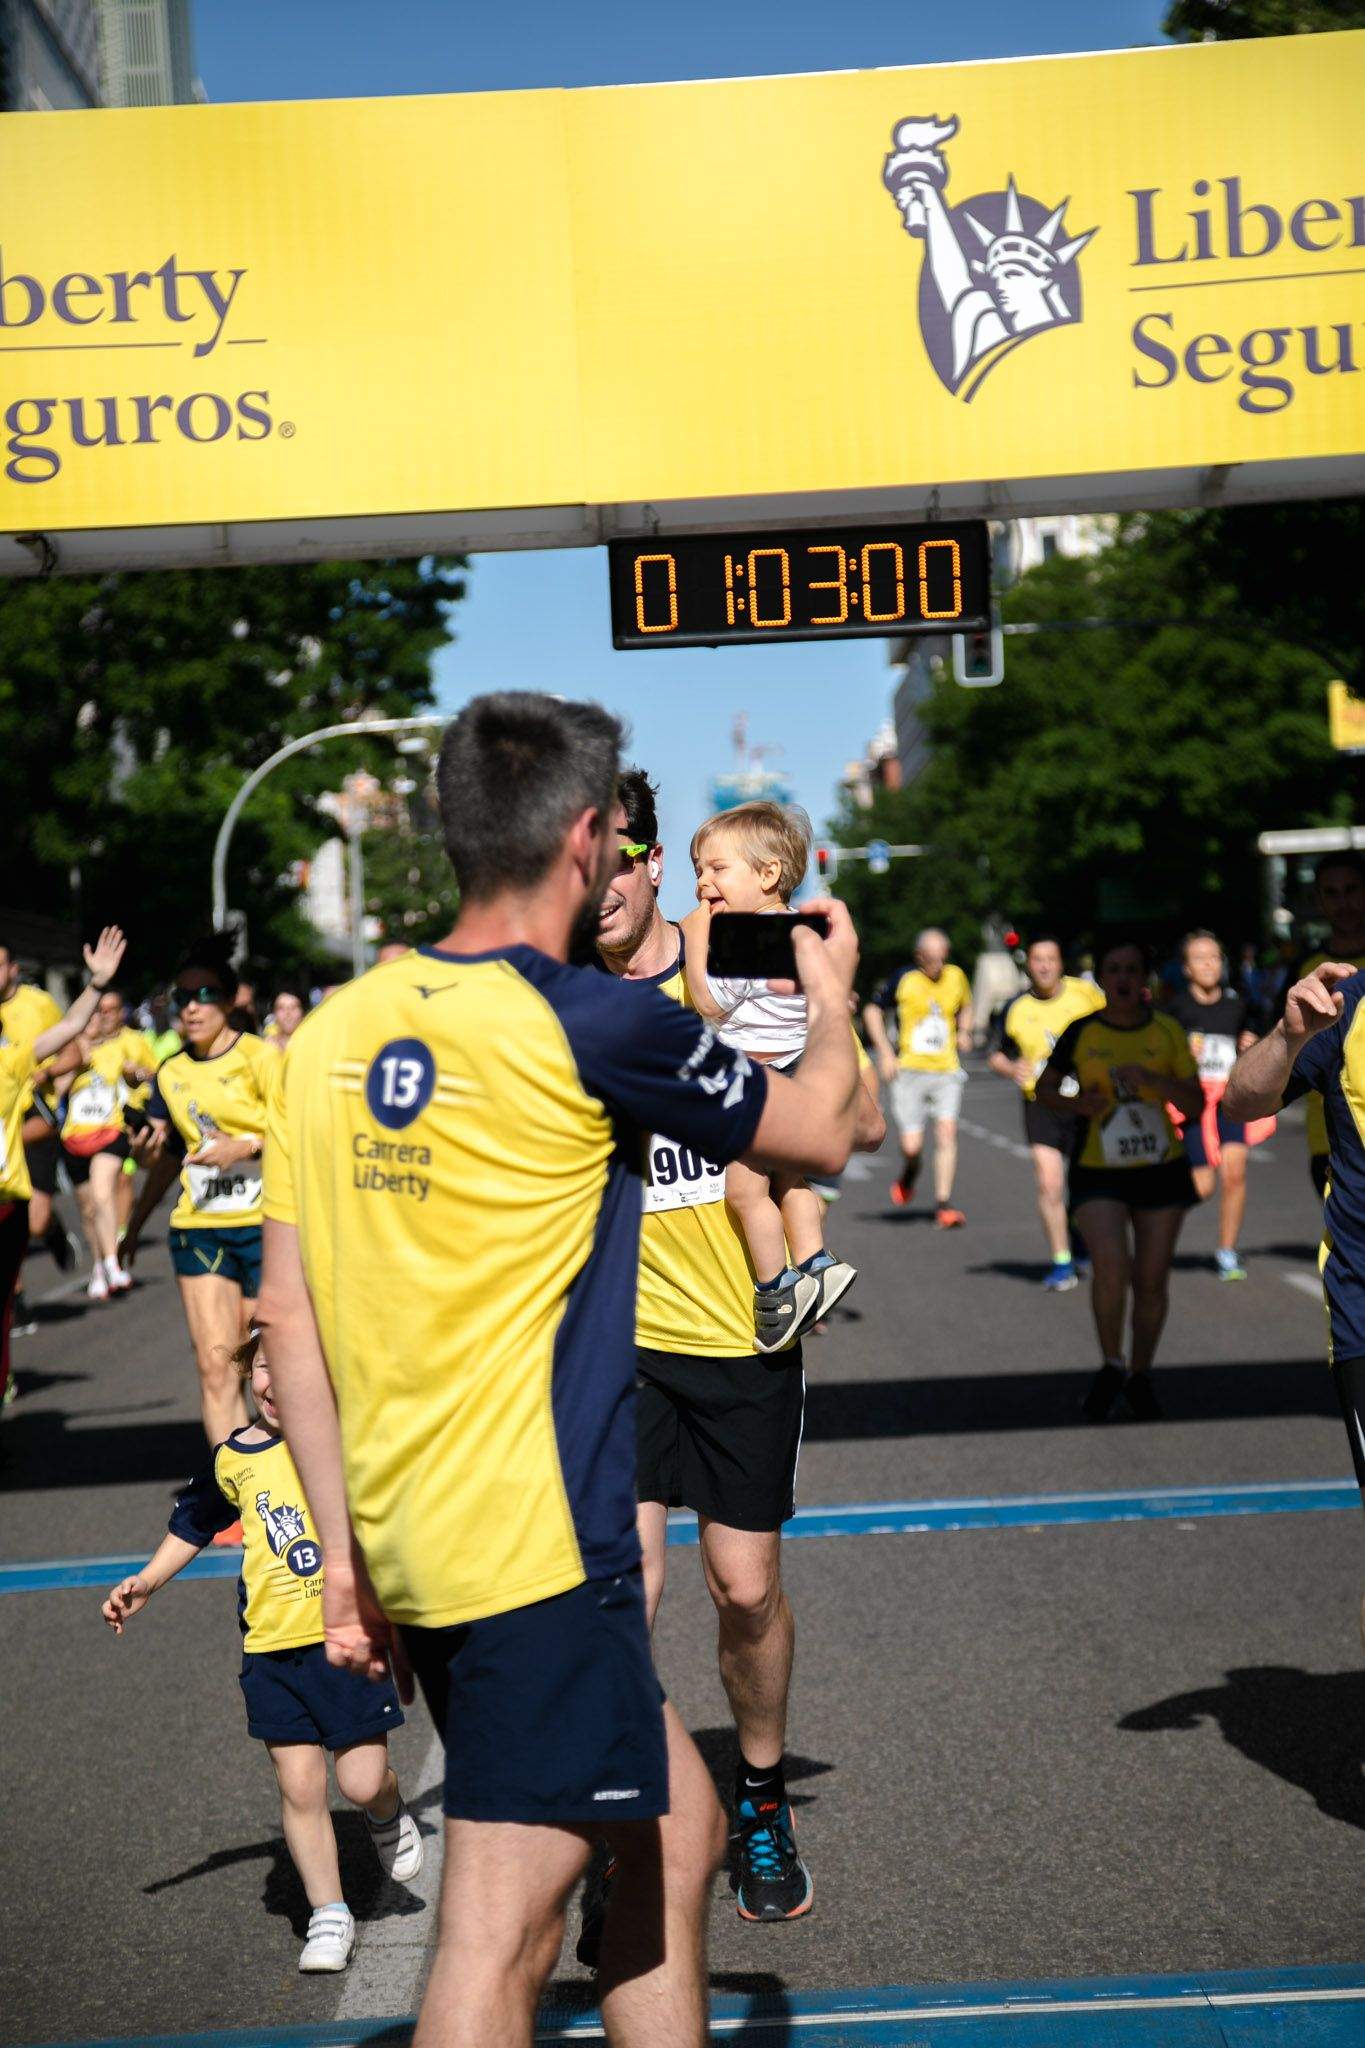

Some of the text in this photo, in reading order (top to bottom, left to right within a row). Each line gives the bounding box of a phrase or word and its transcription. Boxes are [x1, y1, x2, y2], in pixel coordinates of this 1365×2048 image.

[1131, 312, 1365, 413] Segu
[381, 1056, 425, 1109] 13
[353, 1133, 431, 1165] Carrera
[353, 1164, 431, 1201] Liberty
[292, 1547, 317, 1569] 13
